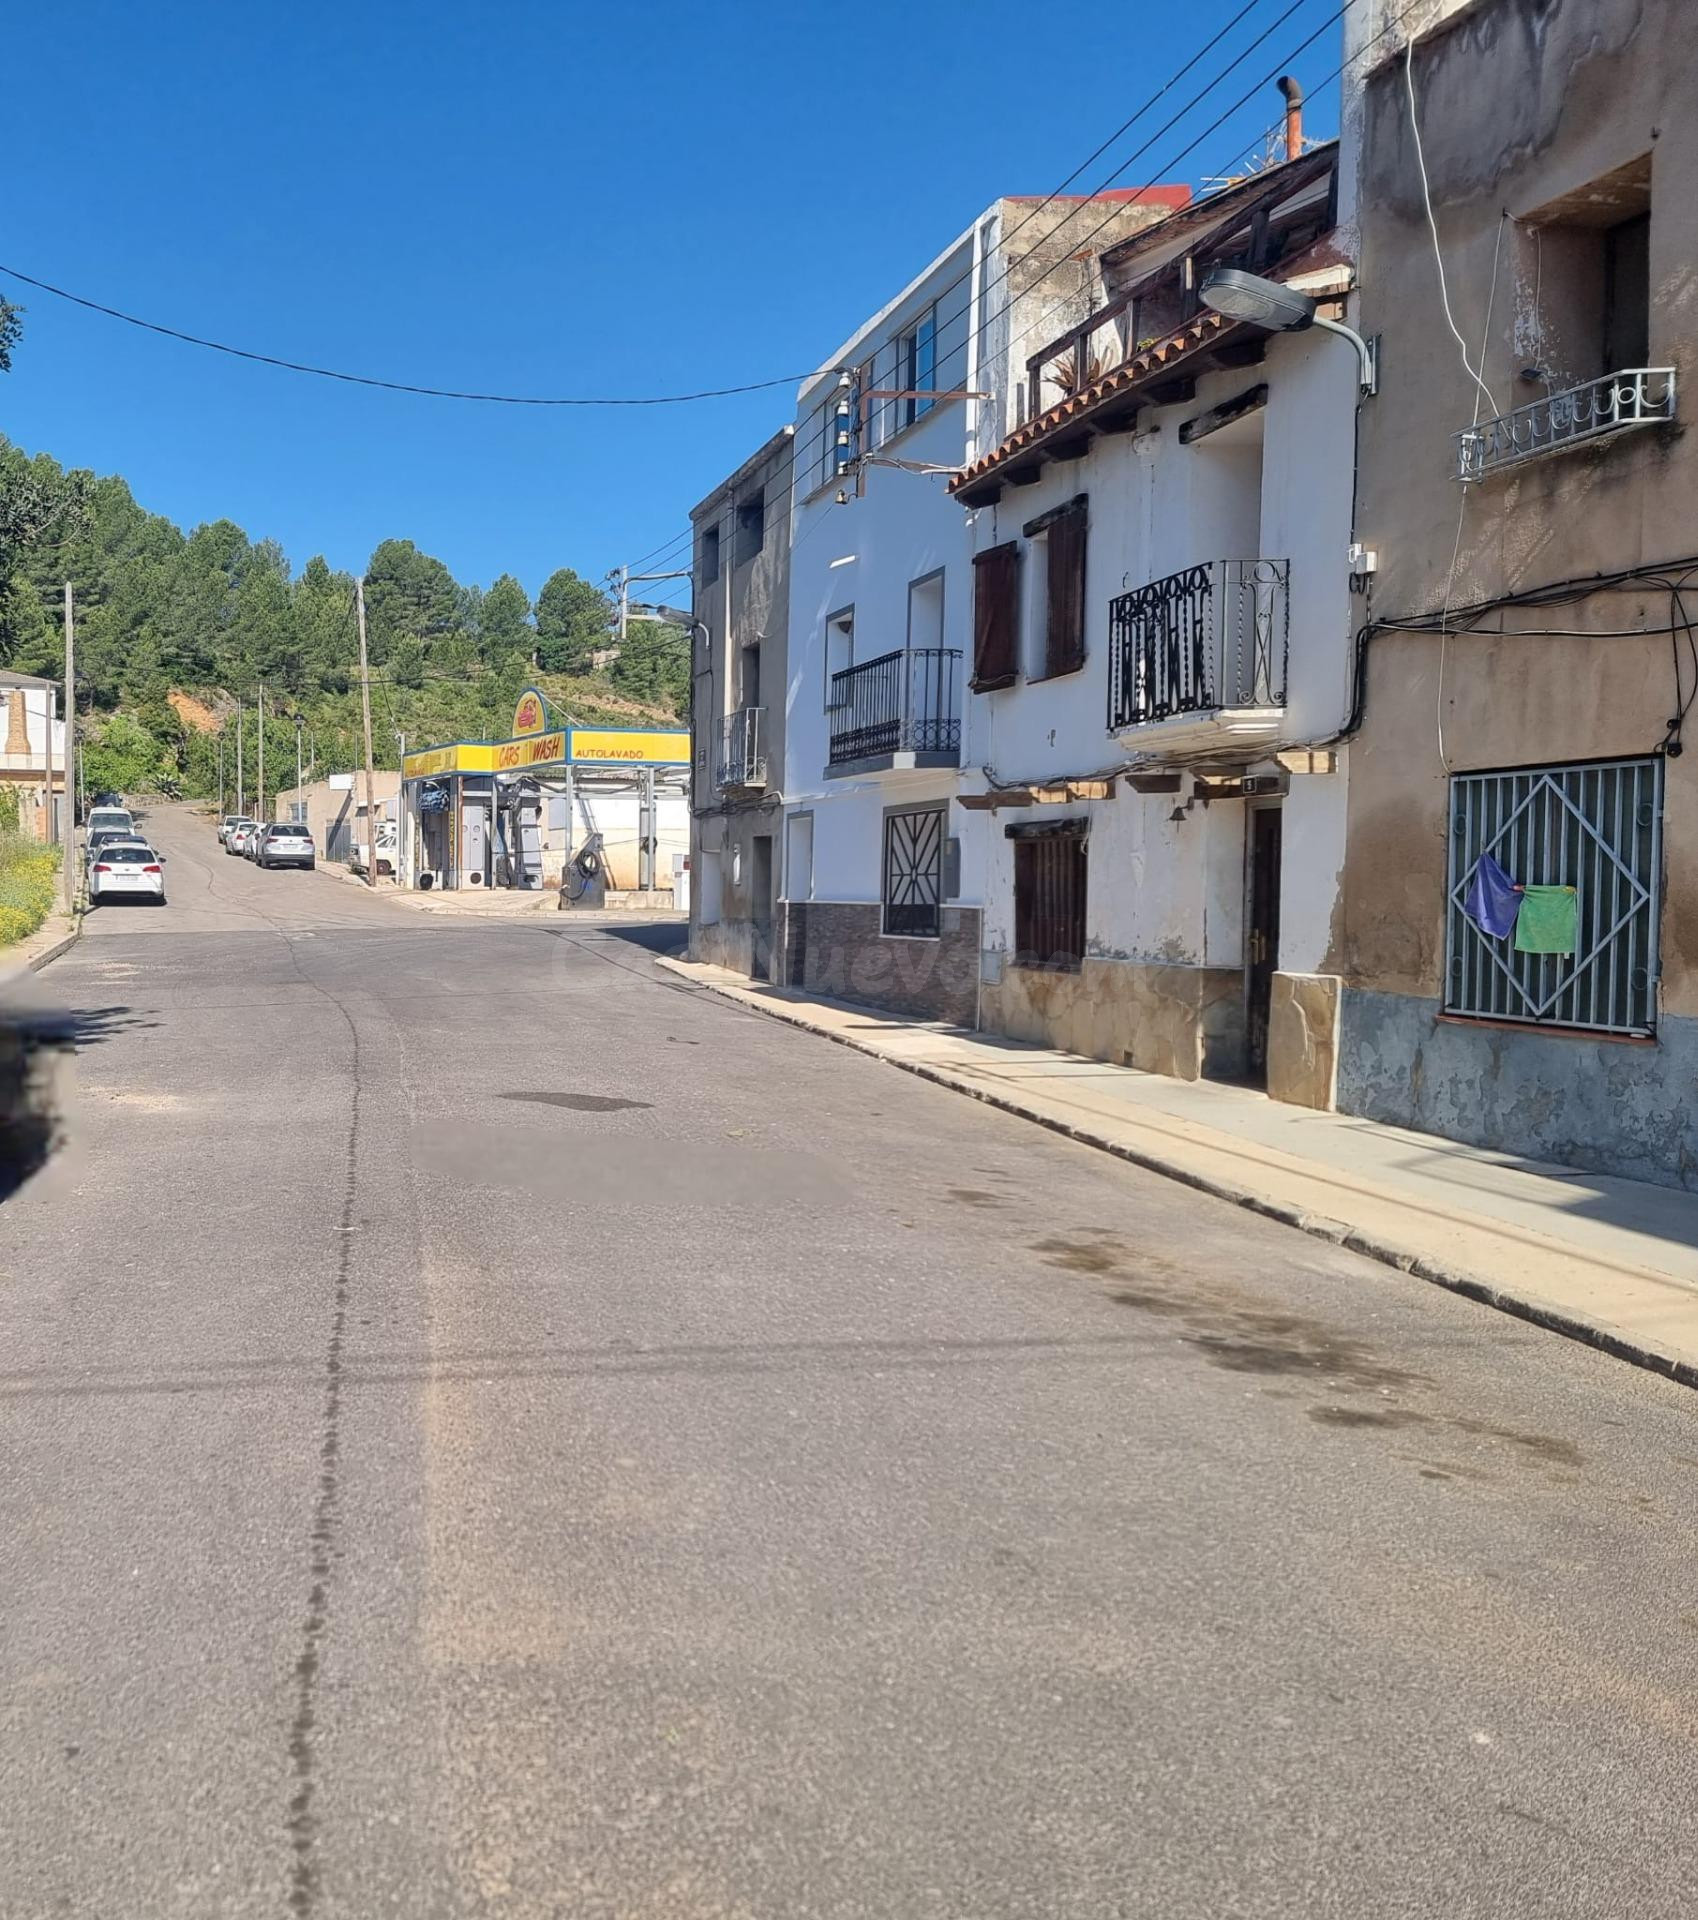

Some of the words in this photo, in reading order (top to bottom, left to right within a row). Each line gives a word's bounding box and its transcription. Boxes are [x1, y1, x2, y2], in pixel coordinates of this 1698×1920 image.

[498, 745, 521, 768] CARS
[532, 736, 561, 761] WASH
[575, 749, 645, 760] AUTOLAVADO
